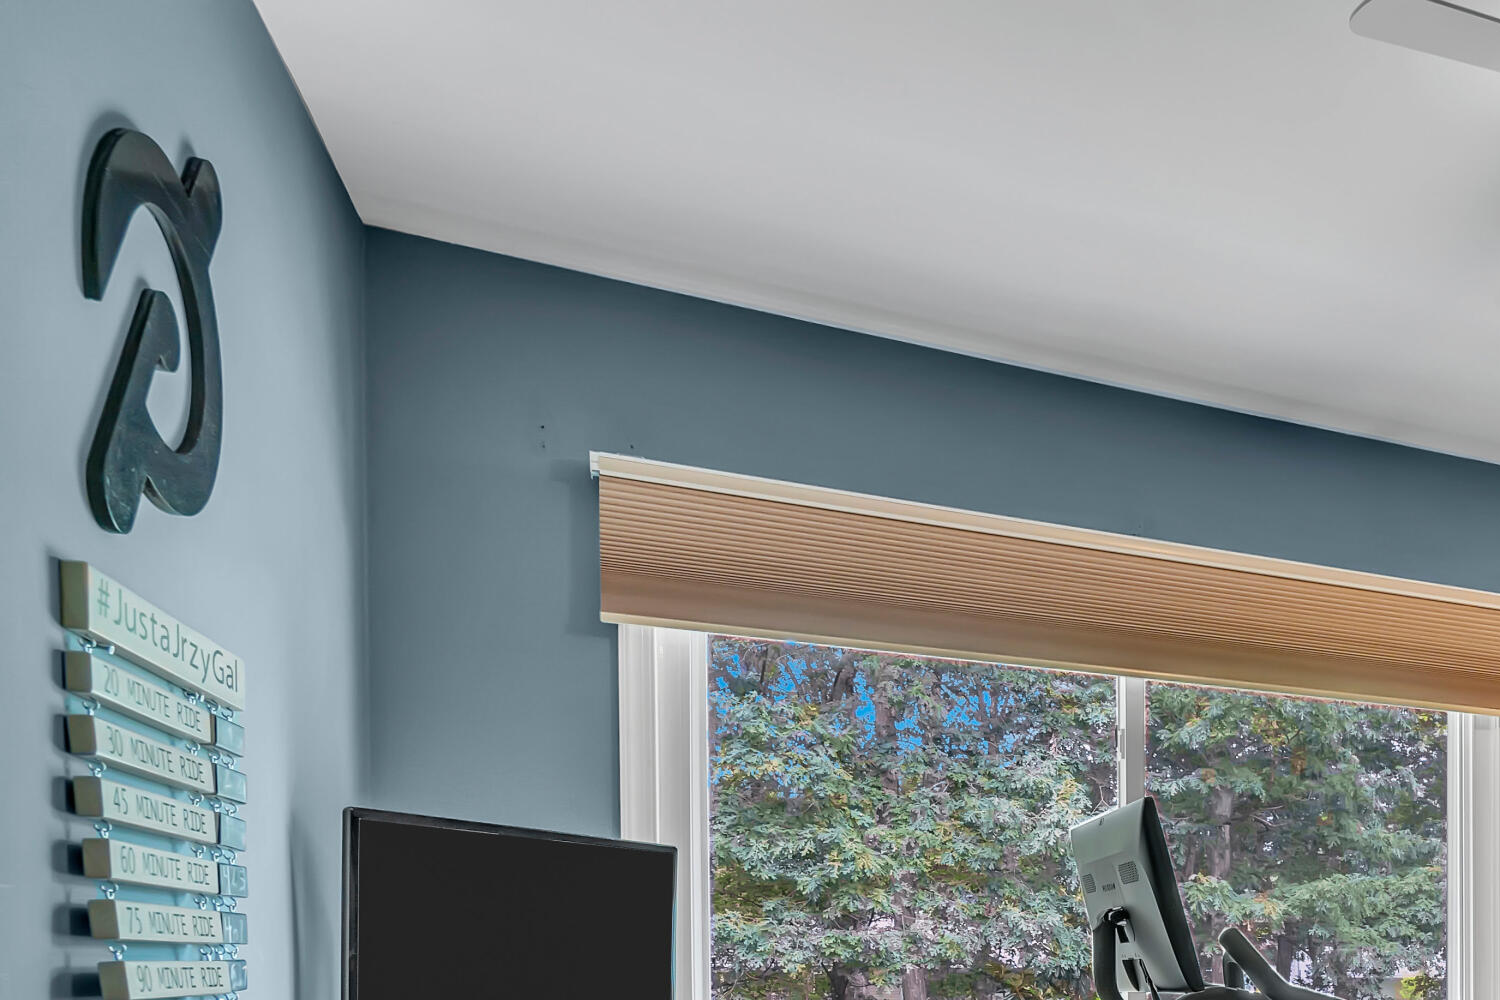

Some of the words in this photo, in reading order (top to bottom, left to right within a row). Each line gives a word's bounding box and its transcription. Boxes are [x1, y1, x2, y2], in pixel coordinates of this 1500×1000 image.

[97, 578, 238, 693] #JustaJrzyGal
[104, 665, 119, 696] 20
[127, 678, 170, 718] MINUTE
[177, 701, 202, 732] RIDE
[106, 726, 123, 756] 30
[130, 737, 174, 773] MINUTE
[180, 756, 205, 784] RIDE
[113, 787, 128, 815] 45
[136, 793, 177, 826] MINUTE
[183, 809, 207, 834] RIDE
[120, 845, 135, 874] 60
[142, 853, 182, 881] MINUTE
[187, 861, 210, 886] RIDE
[126, 907, 143, 934] 75
[148, 911, 188, 936] MINUTE
[192, 915, 216, 937] RIDE
[137, 965, 153, 992] 90
[157, 967, 196, 989] MINUTE
[200, 966, 224, 987] RIDE
